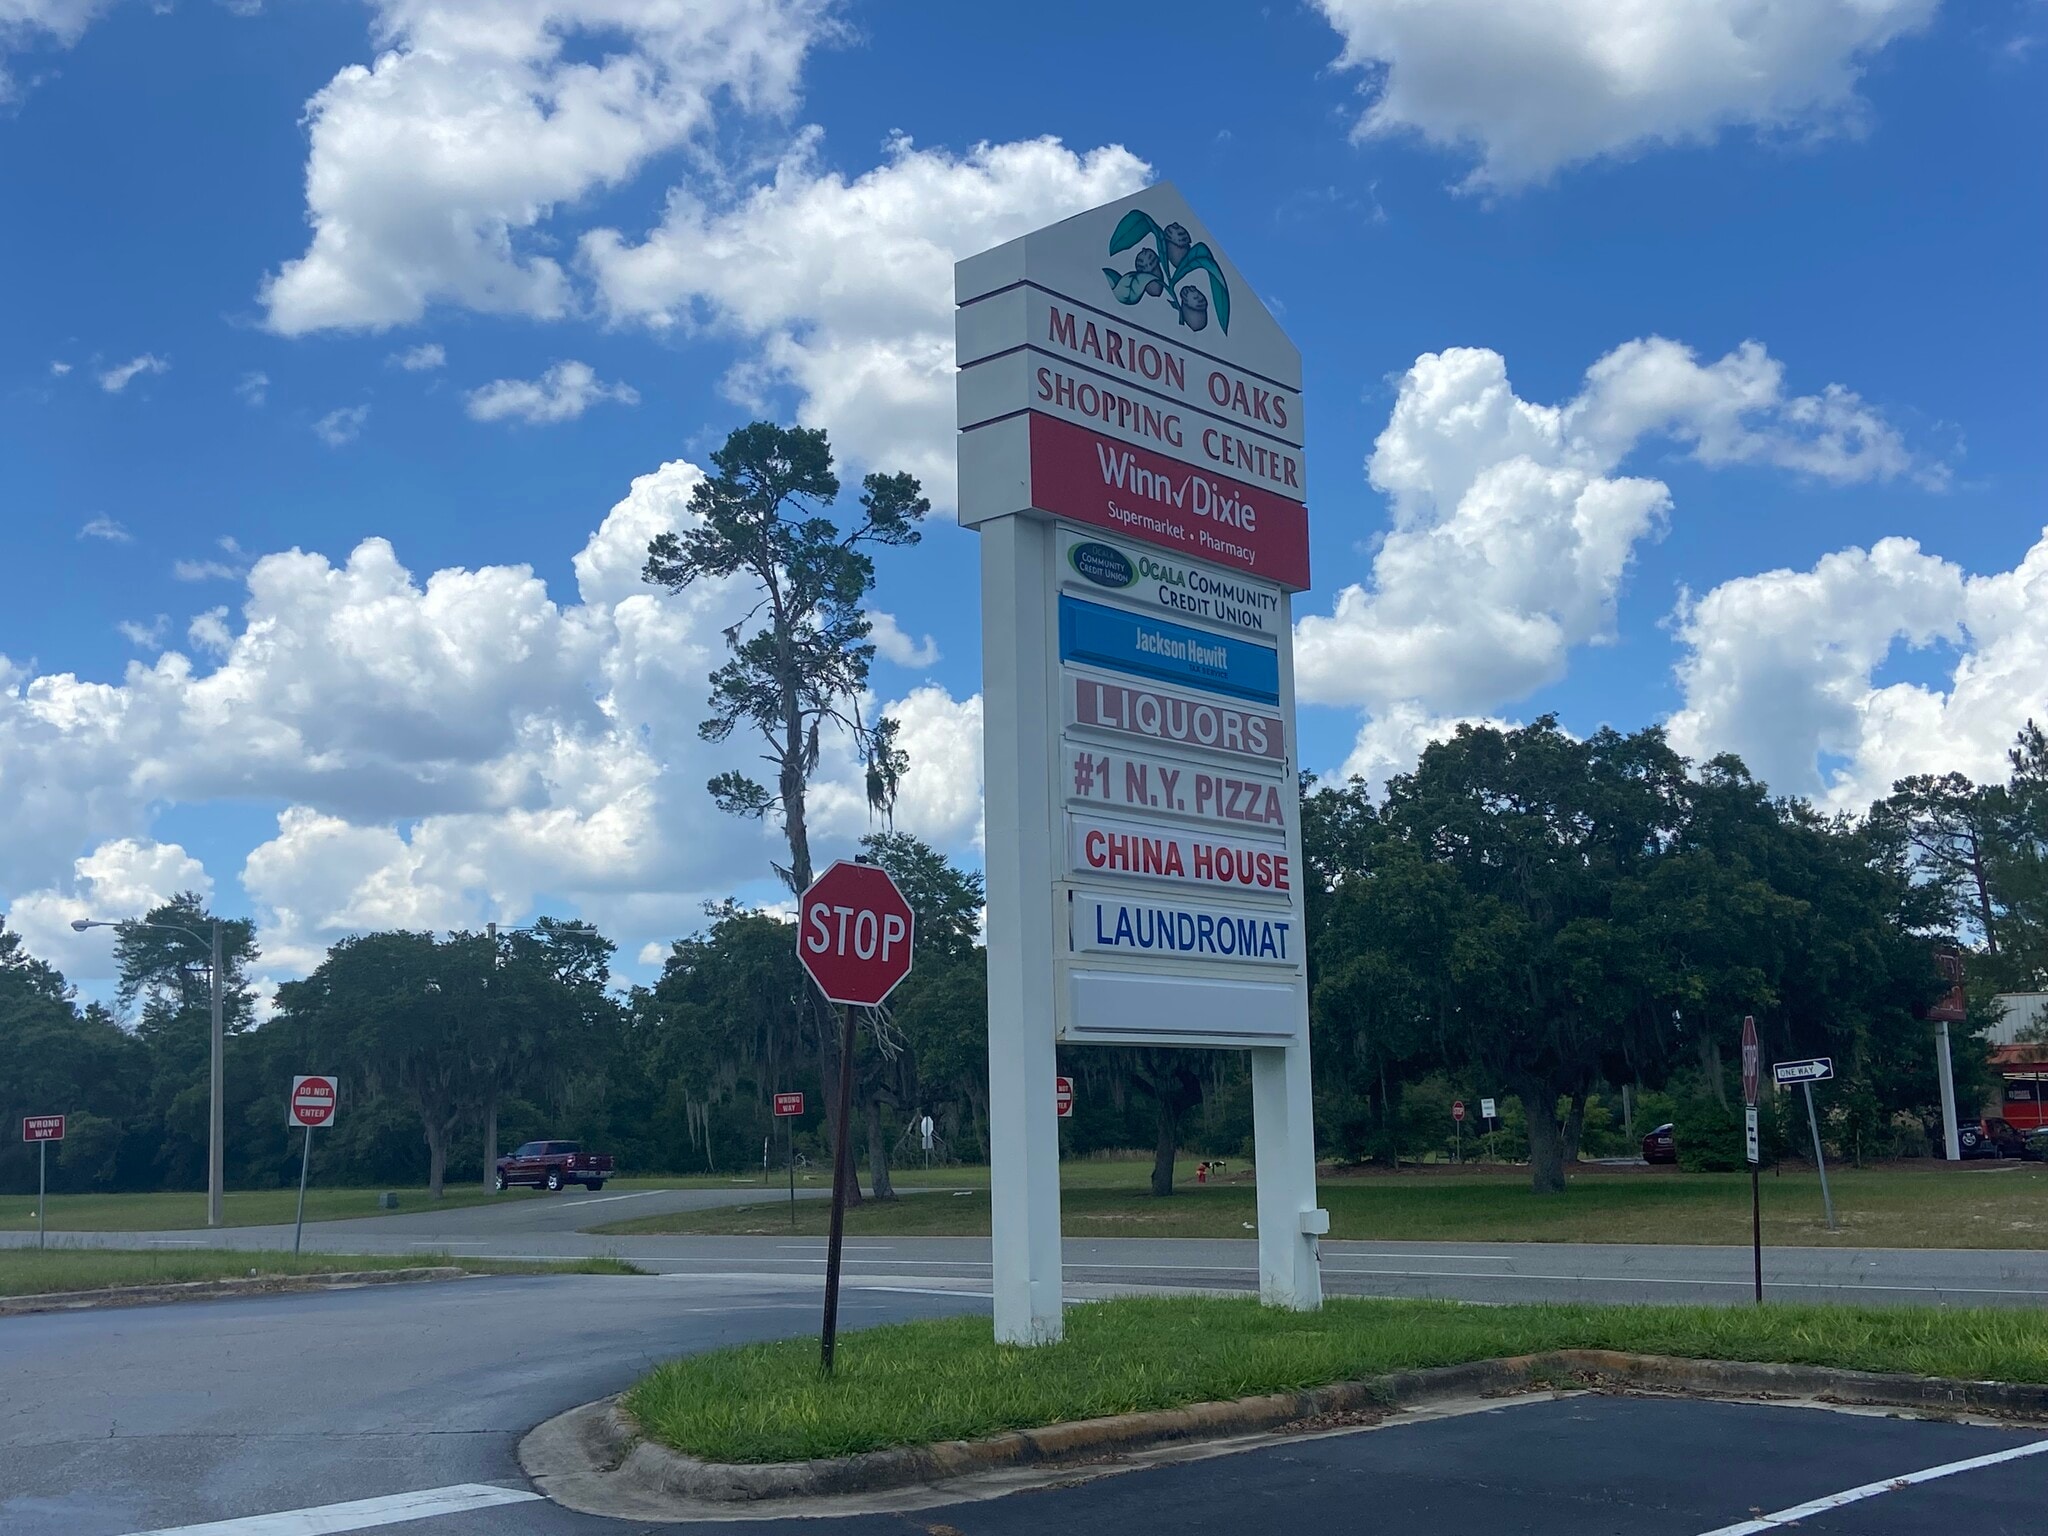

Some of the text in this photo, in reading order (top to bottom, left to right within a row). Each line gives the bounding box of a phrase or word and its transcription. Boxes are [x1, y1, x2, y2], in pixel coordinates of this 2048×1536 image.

[1049, 306, 1288, 429] MARION OAKS
[1037, 367, 1299, 488] SHOPPING CENTER
[1096, 442, 1256, 532] Winn Dixie
[1108, 501, 1256, 565] Supermarket Pharmacy
[1080, 561, 1128, 583] CREDIT UNION
[1081, 552, 1125, 572] COMMUNITY
[1139, 557, 1278, 612] OCALA COMMUNITY
[1159, 585, 1262, 629] CREDIT UNION
[1136, 627, 1227, 670] Jackson Hewitt
[1096, 685, 1268, 755] LIQUORS
[1074, 752, 1284, 826] #1 N.Y. PIZZA
[1085, 830, 1290, 890] CHINA HOUSE
[807, 902, 905, 962] STOP
[1096, 904, 1289, 959] LAUNDROMAT
[300, 1086, 330, 1096] DO NOT
[1780, 1066, 1814, 1077] ONE WAY
[29, 1119, 60, 1129] WRONG
[300, 1109, 325, 1118] ENTER
[778, 1096, 800, 1104] WRONG
[35, 1129, 53, 1138] WAY
